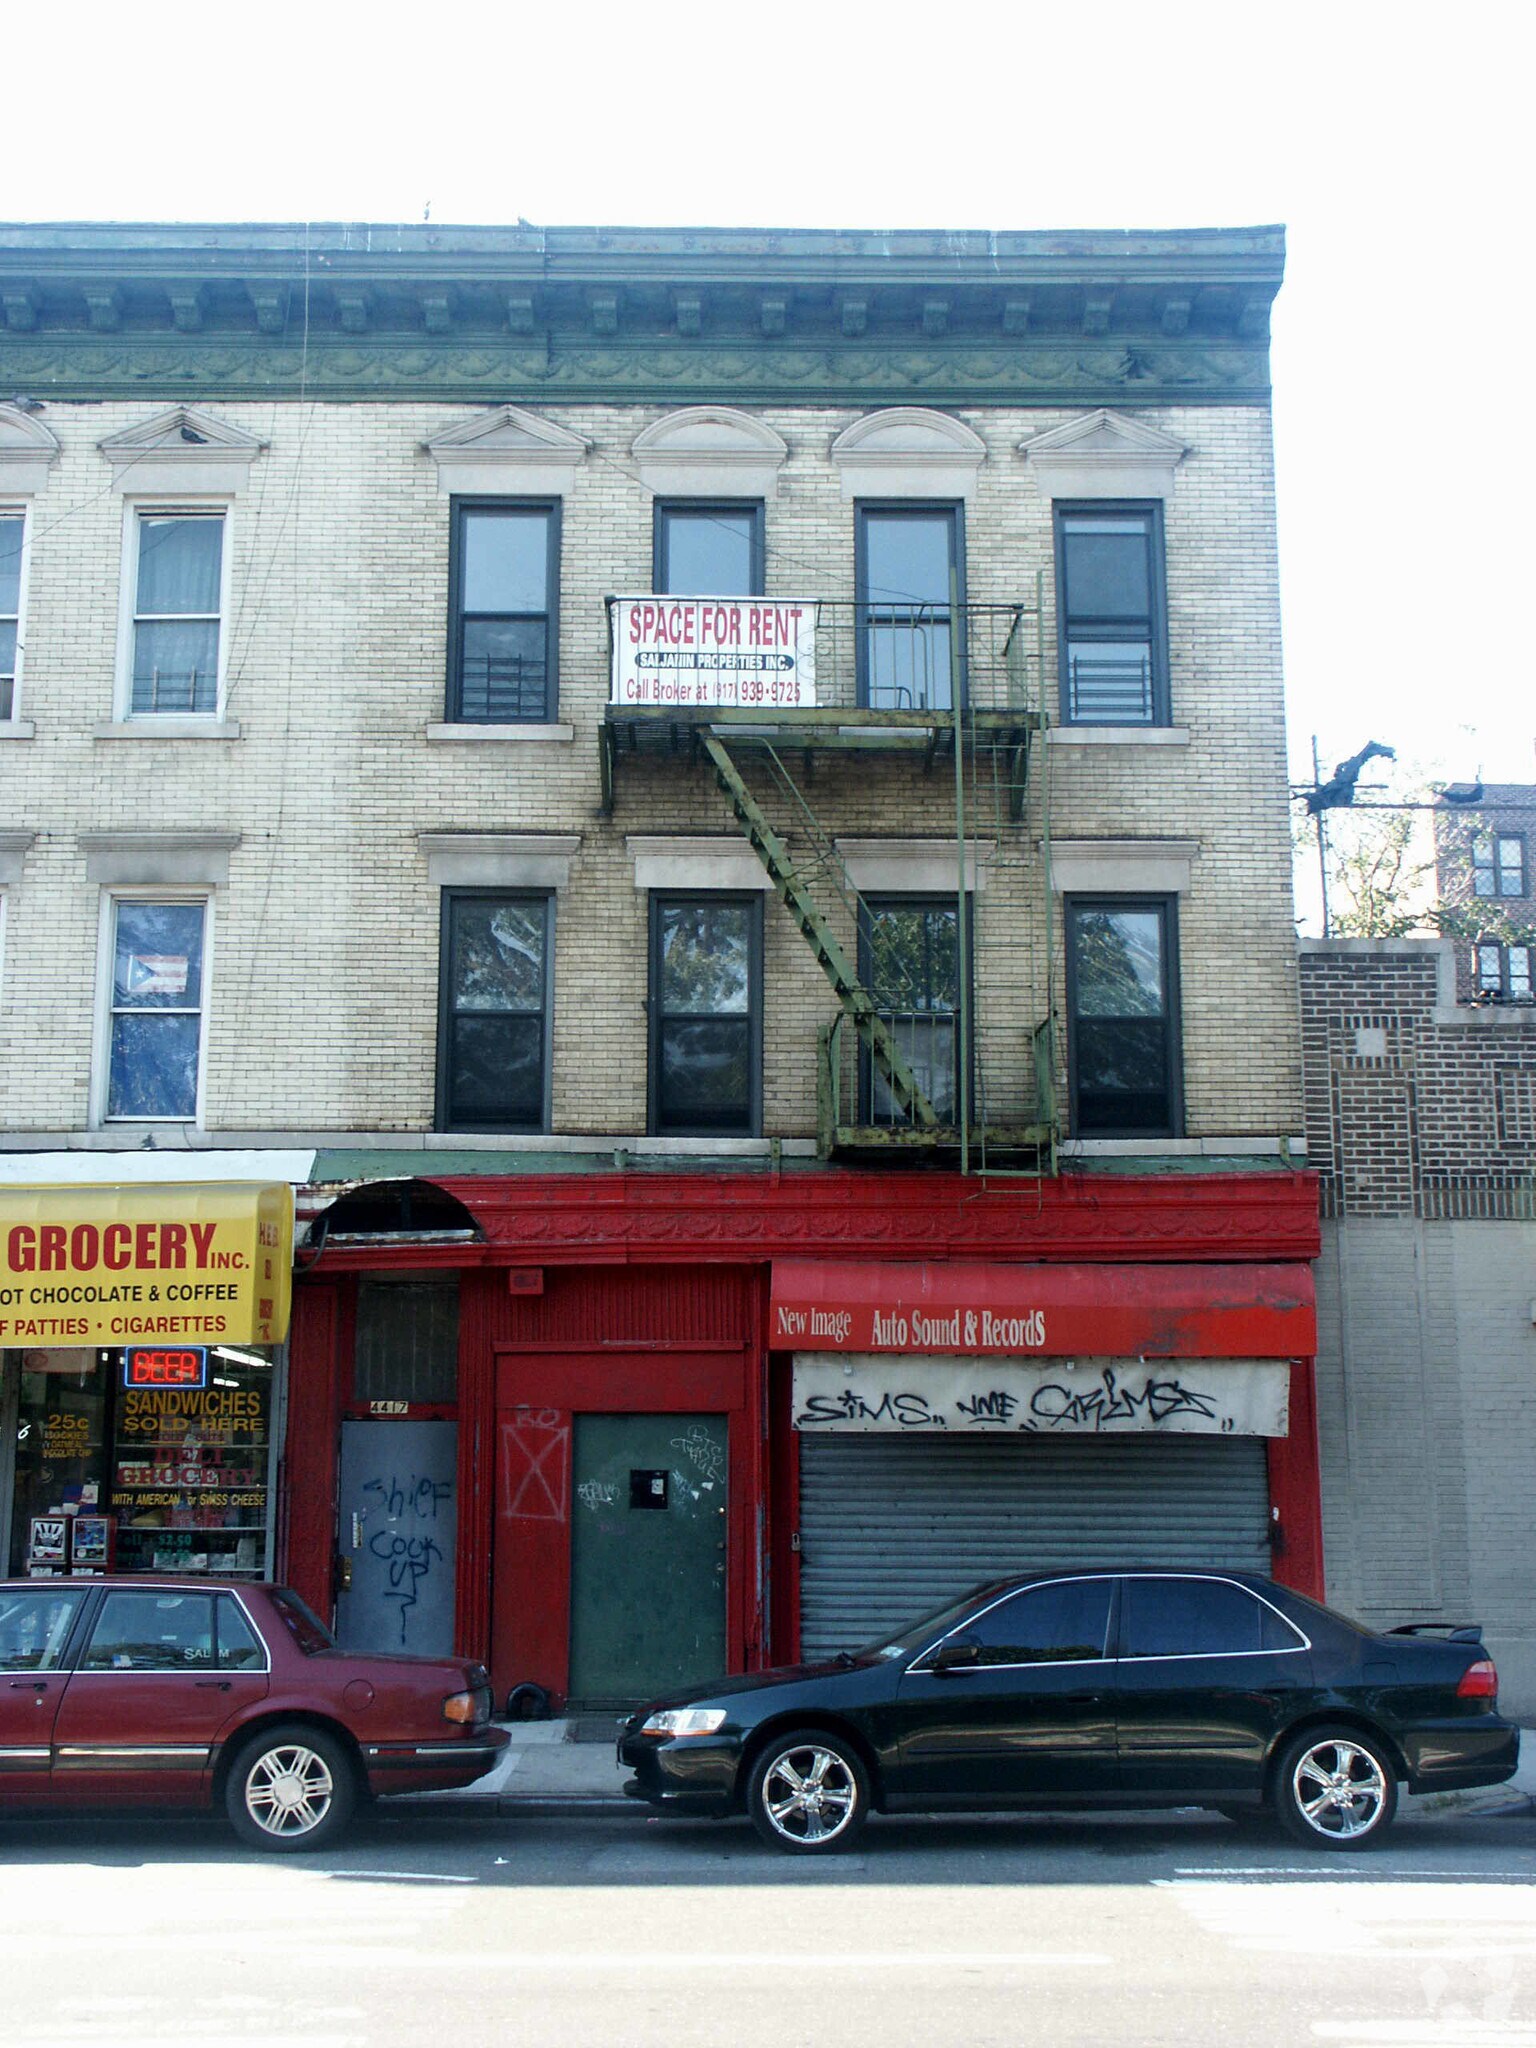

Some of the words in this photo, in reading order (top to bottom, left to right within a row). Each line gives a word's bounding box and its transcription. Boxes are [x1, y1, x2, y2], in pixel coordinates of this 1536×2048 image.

[629, 605, 694, 644] SPACE
[702, 607, 741, 645] FOR
[749, 608, 802, 646] RENT
[699, 655, 763, 670] PROPERTIES
[765, 656, 789, 670] INC.
[626, 678, 648, 699] Call
[653, 679, 691, 700] Broker
[696, 684, 707, 700] at
[8, 1223, 217, 1272] GROCERY
[210, 1252, 250, 1269] INC.
[30, 1285, 142, 1304] CHOCOLATE
[149, 1286, 160, 1301] &
[166, 1284, 238, 1301] COFFEE
[14, 1318, 89, 1336] PATTIES
[110, 1315, 226, 1334] CIGARETTES
[777, 1306, 807, 1335] New
[810, 1306, 852, 1343] Image
[871, 1313, 907, 1346] Auto
[911, 1309, 961, 1347] Sound
[964, 1310, 978, 1346] &
[133, 1352, 197, 1381] BEER
[126, 1391, 261, 1416] SANDWICHES
[371, 1401, 407, 1412] 4417
[124, 1417, 189, 1431] SOLD
[201, 1417, 265, 1431] HERE
[154, 1447, 225, 1465] DELI
[116, 1467, 256, 1486] GROCERY
[112, 1493, 133, 1505] WITH
[136, 1493, 181, 1506] AMERICAN
[200, 1493, 228, 1506] SWISS
[231, 1493, 266, 1506] CHEESE
[183, 1647, 230, 1660] SALM
